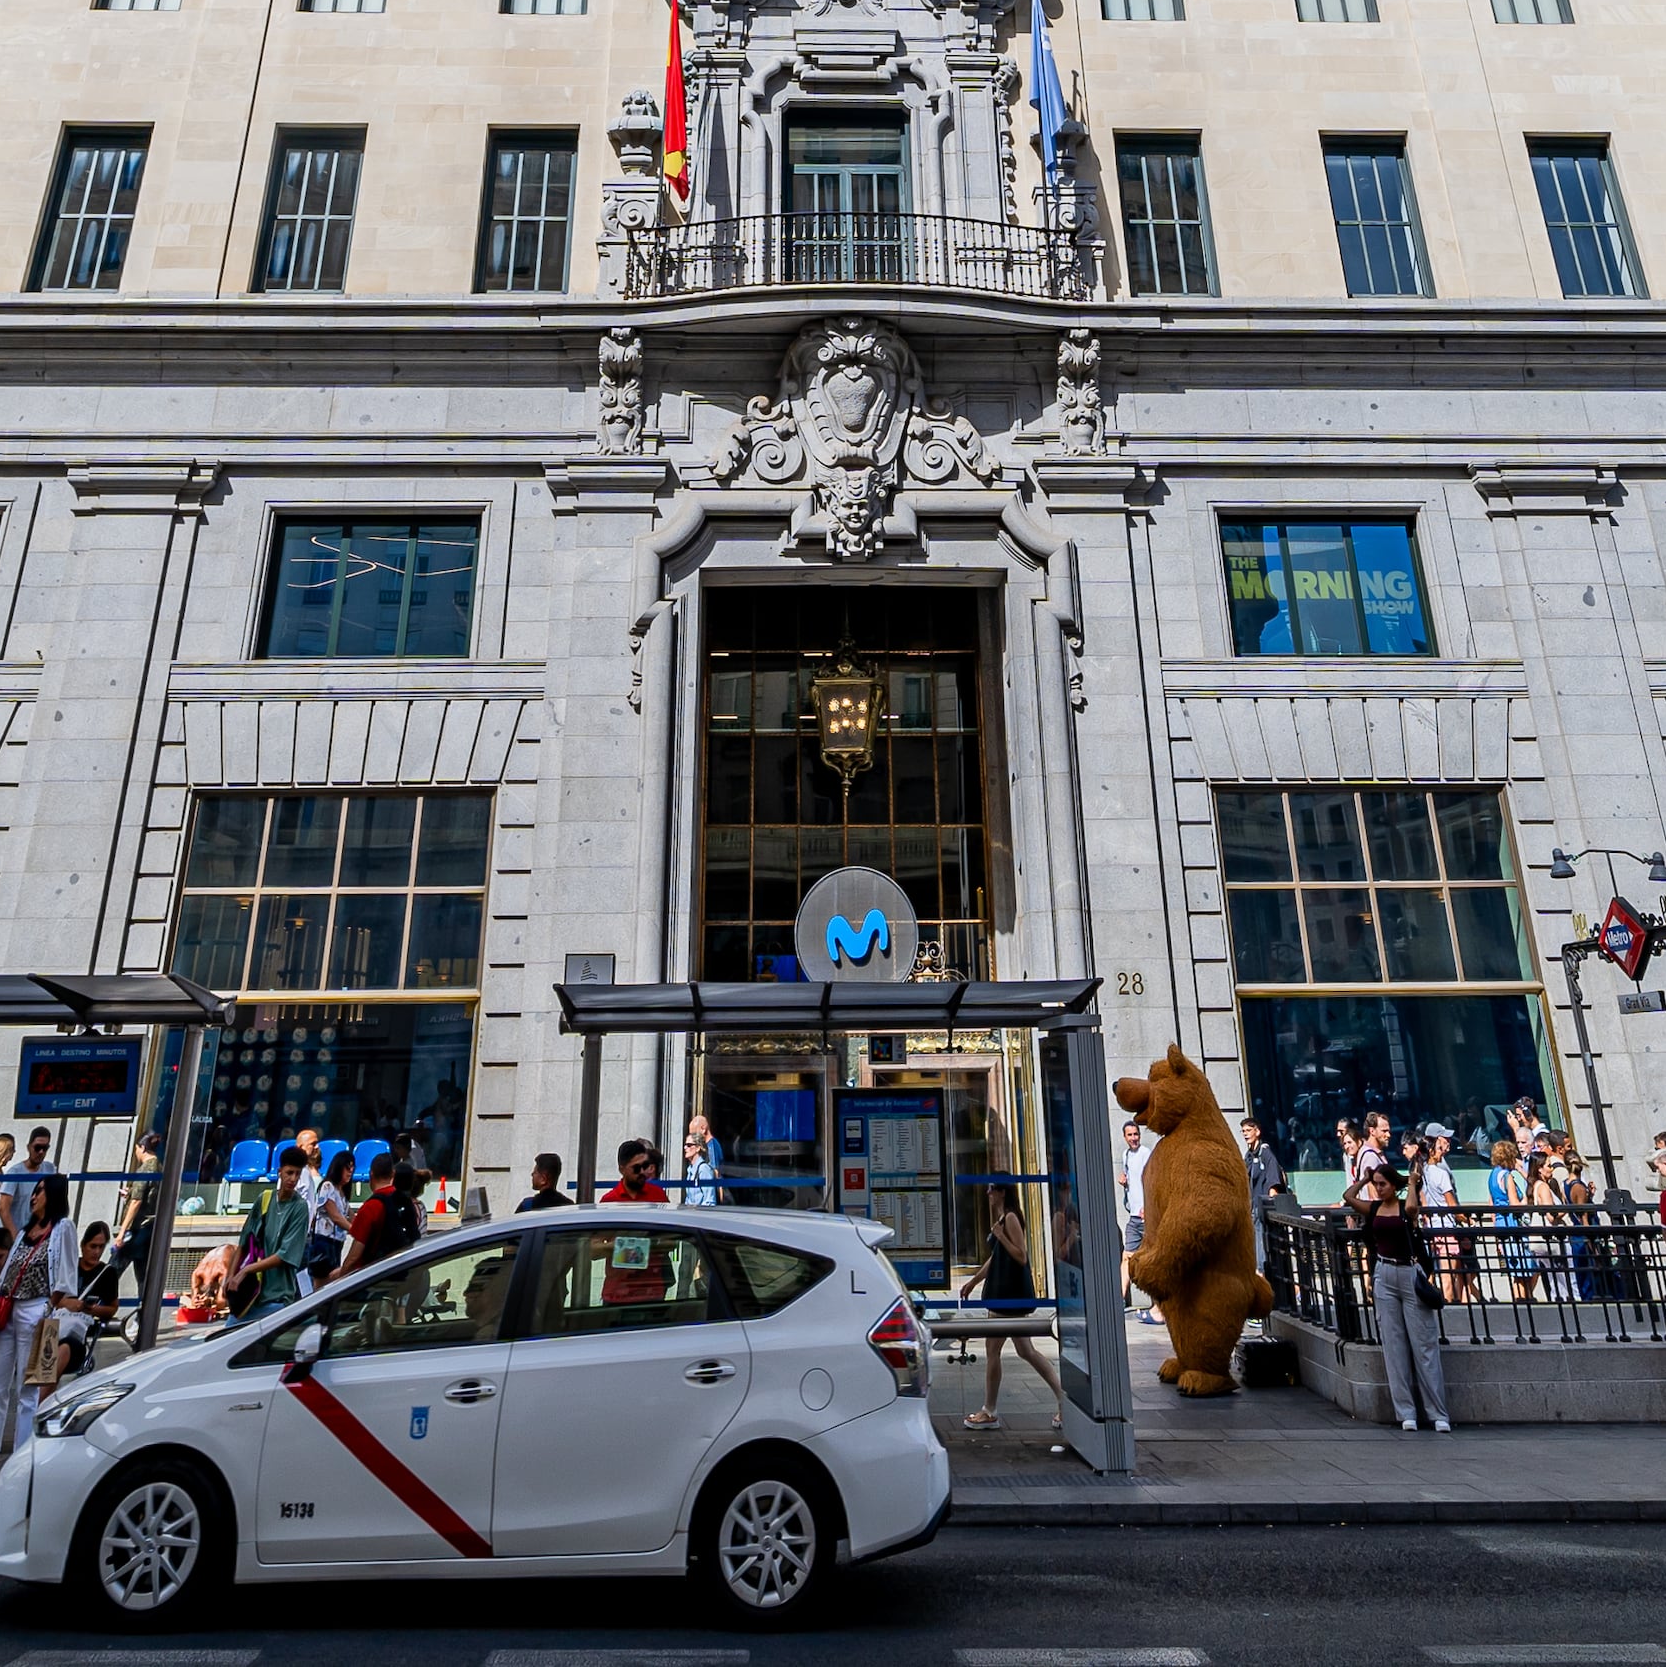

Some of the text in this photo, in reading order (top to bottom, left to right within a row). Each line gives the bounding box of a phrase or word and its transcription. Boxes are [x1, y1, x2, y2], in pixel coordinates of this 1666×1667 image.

[1229, 557, 1259, 569] THE
[1231, 570, 1413, 600] MORNING
[1364, 600, 1415, 615] SHOW
[1607, 930, 1629, 948] Metro
[1117, 972, 1144, 995] 28
[1625, 997, 1640, 1009] Gran
[96, 1048, 127, 1056] MINUTOS
[74, 1098, 97, 1108] EMT
[850, 1269, 867, 1295] L
